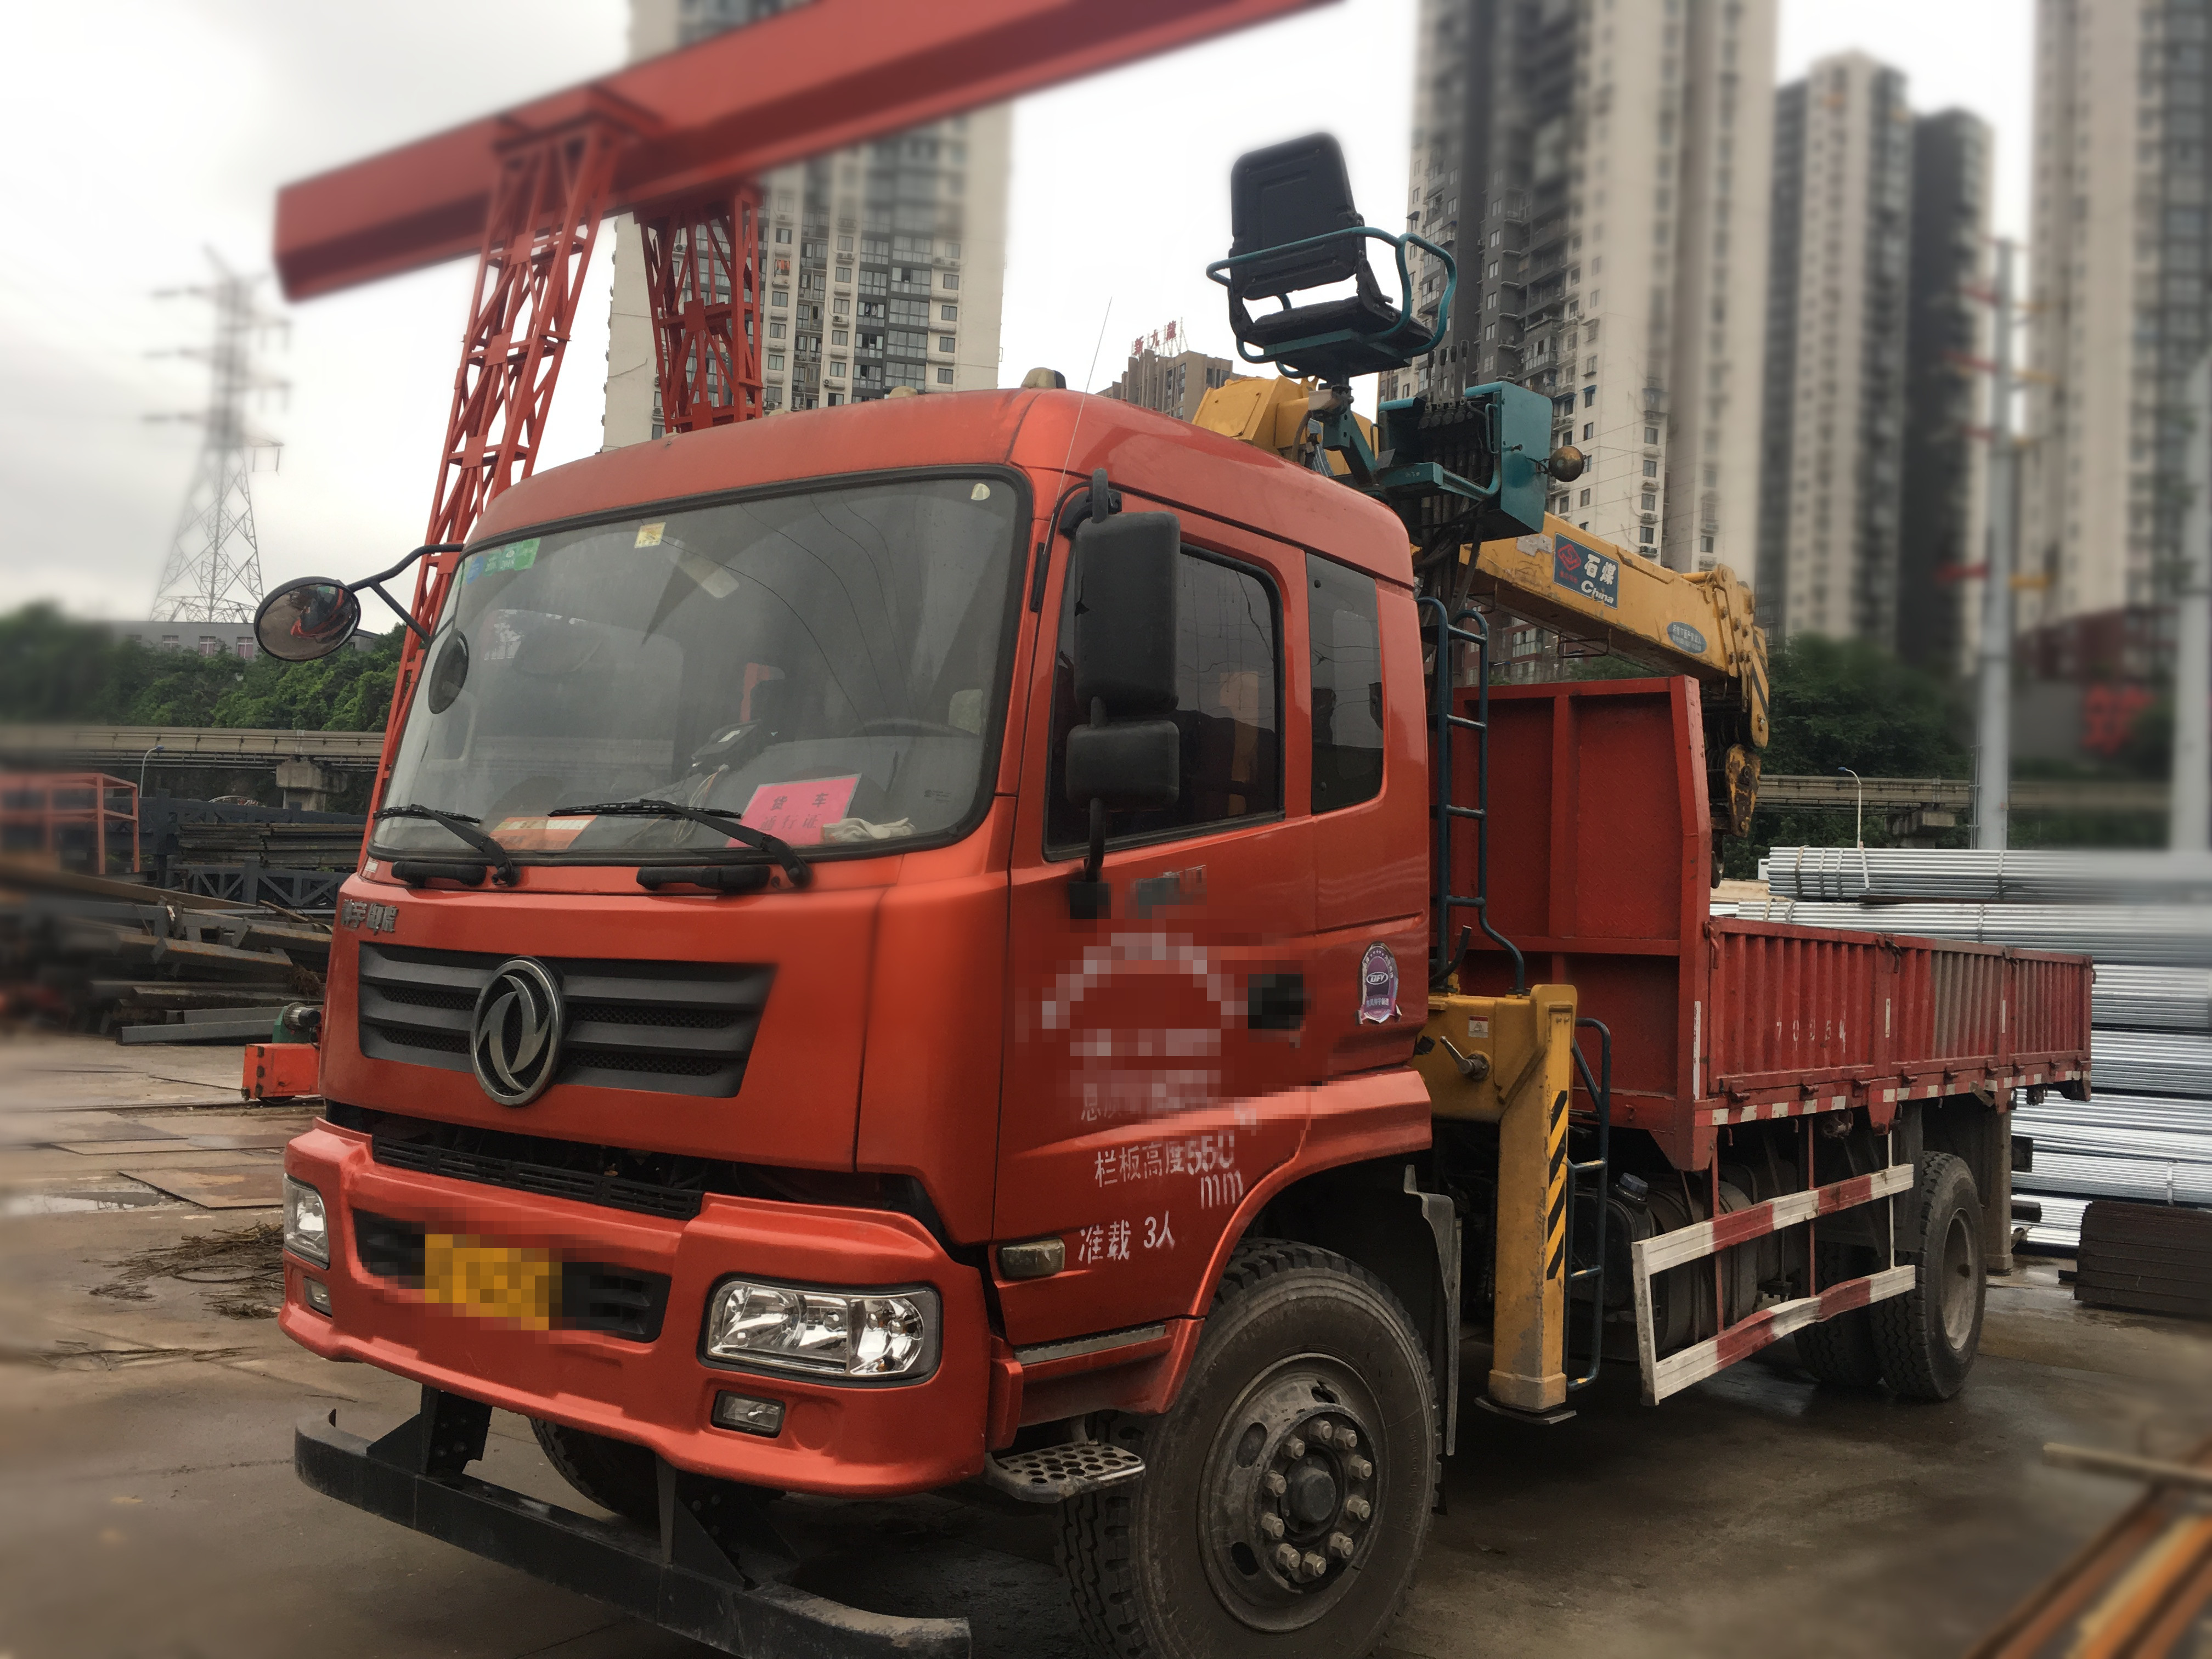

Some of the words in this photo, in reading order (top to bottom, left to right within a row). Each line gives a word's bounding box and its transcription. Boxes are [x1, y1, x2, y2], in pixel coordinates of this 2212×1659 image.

[1584, 554, 1616, 585] 石煤
[1581, 580, 1614, 604] China
[770, 793, 829, 811] 货车
[758, 814, 822, 831] 通行证
[1079, 1219, 1131, 1264] 准载
[1144, 1210, 1176, 1250] 3人
